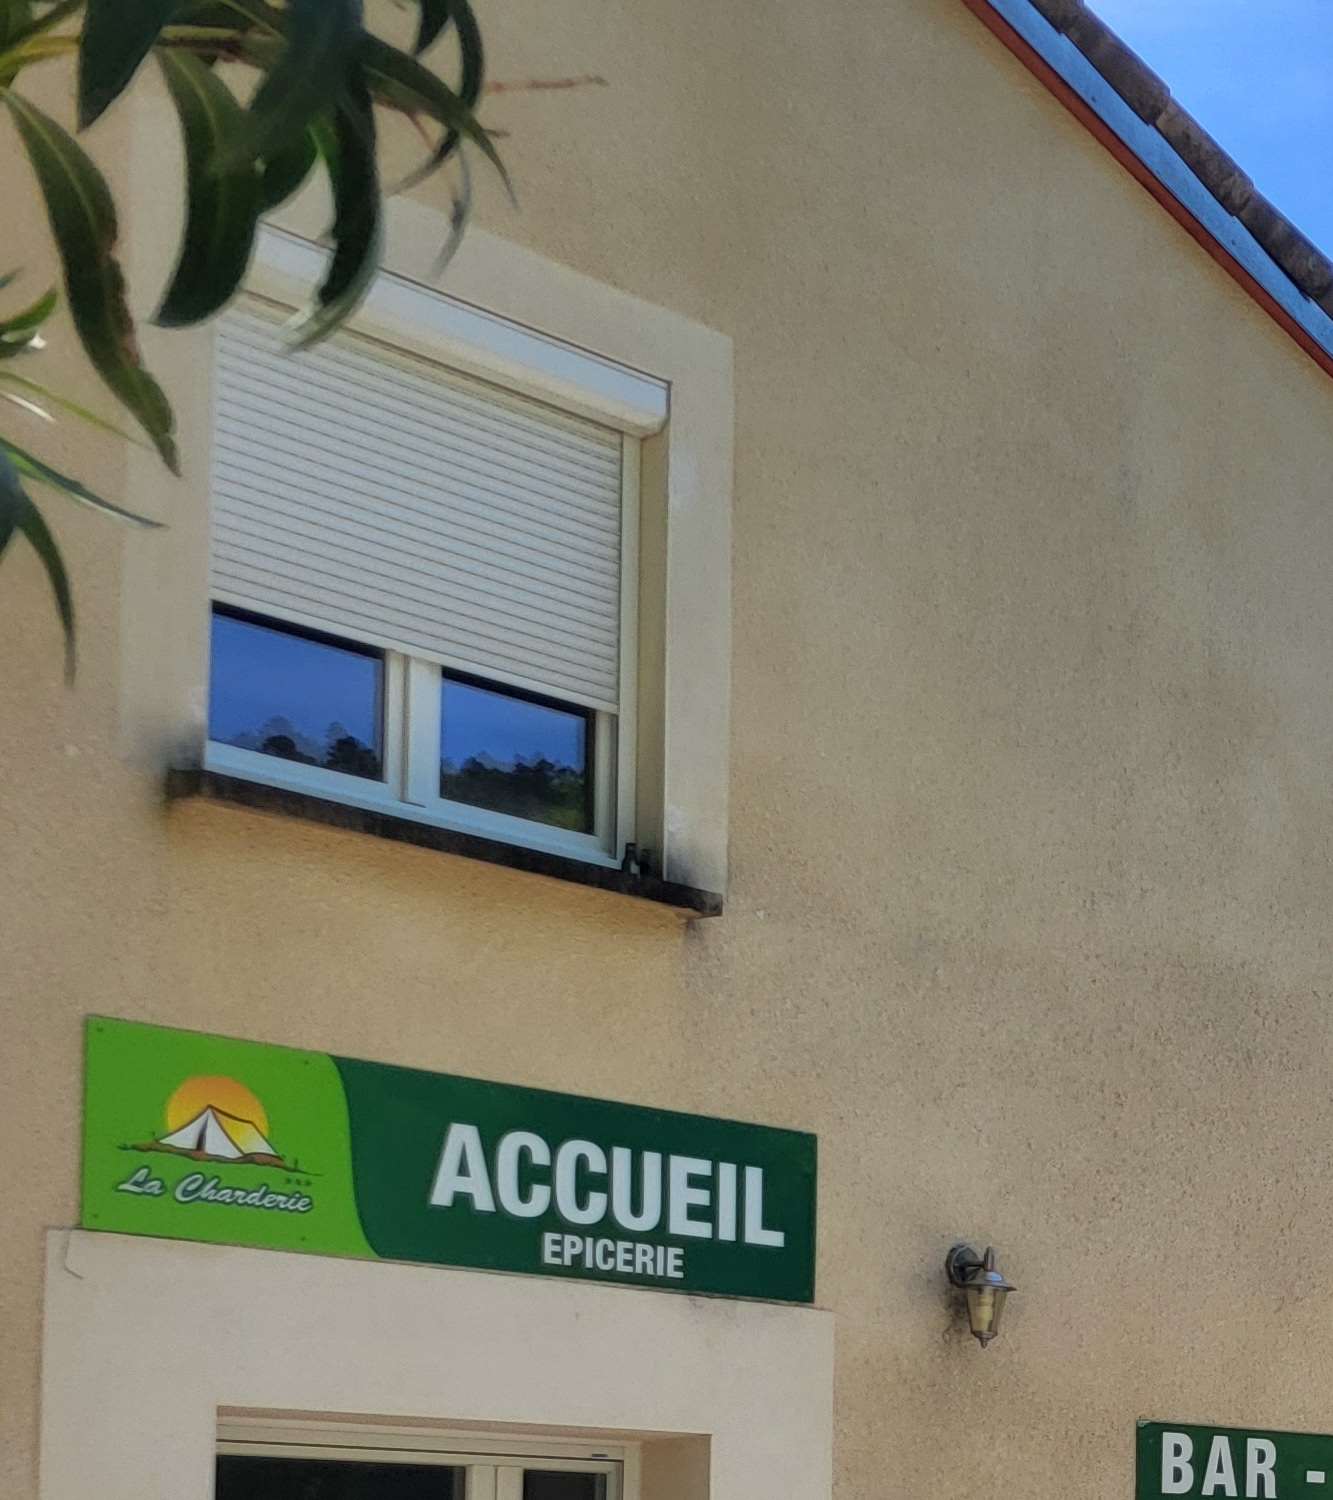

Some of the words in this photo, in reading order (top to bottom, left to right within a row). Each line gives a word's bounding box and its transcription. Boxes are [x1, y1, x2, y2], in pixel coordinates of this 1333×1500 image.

[116, 1166, 165, 1195] La
[174, 1172, 313, 1213] Charderie
[431, 1122, 785, 1248] ACCUEIL
[543, 1231, 684, 1279] EPICERIE
[1161, 1431, 1277, 1499] BAR
